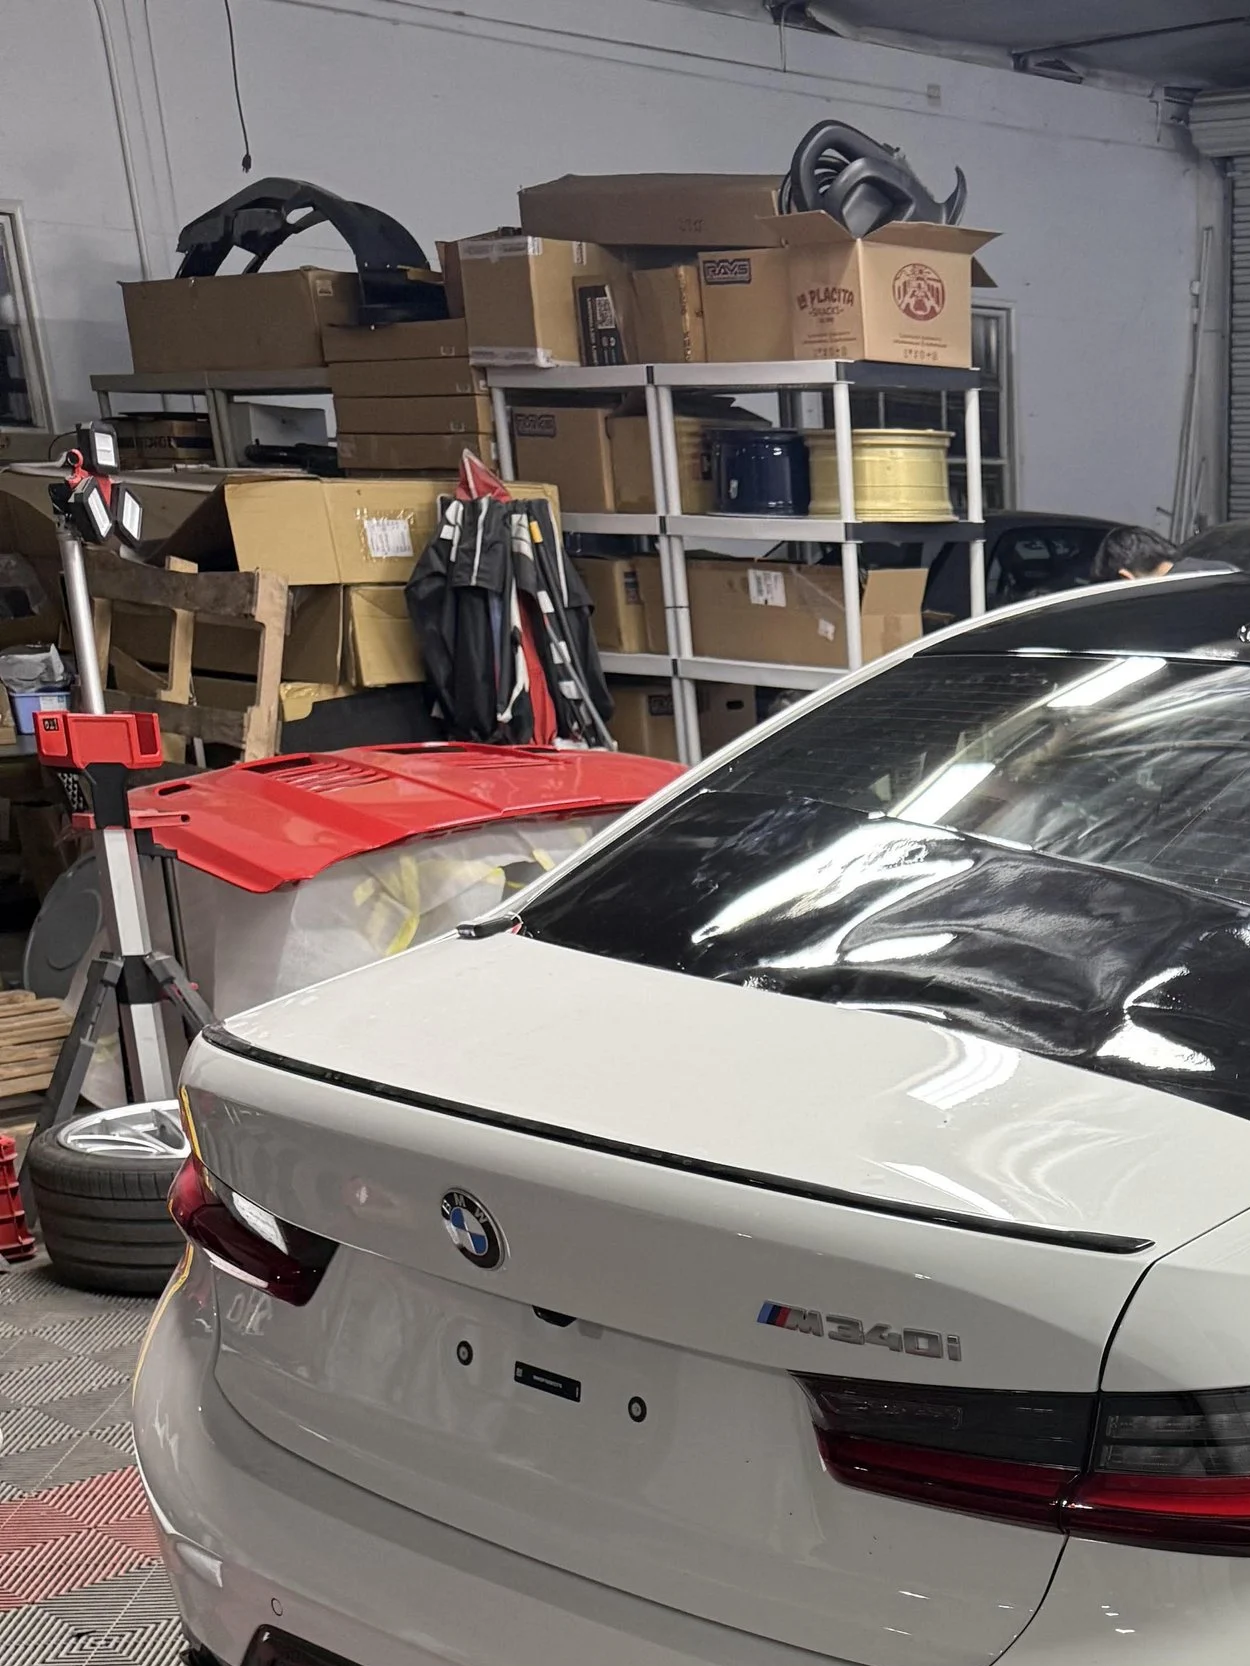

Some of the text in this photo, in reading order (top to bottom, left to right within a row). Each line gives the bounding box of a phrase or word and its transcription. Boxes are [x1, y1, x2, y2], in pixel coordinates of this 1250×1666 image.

[704, 261, 749, 278] RAYS
[809, 286, 855, 306] PLACITA
[441, 1192, 489, 1224] BMW
[781, 1302, 962, 1361] M340i
